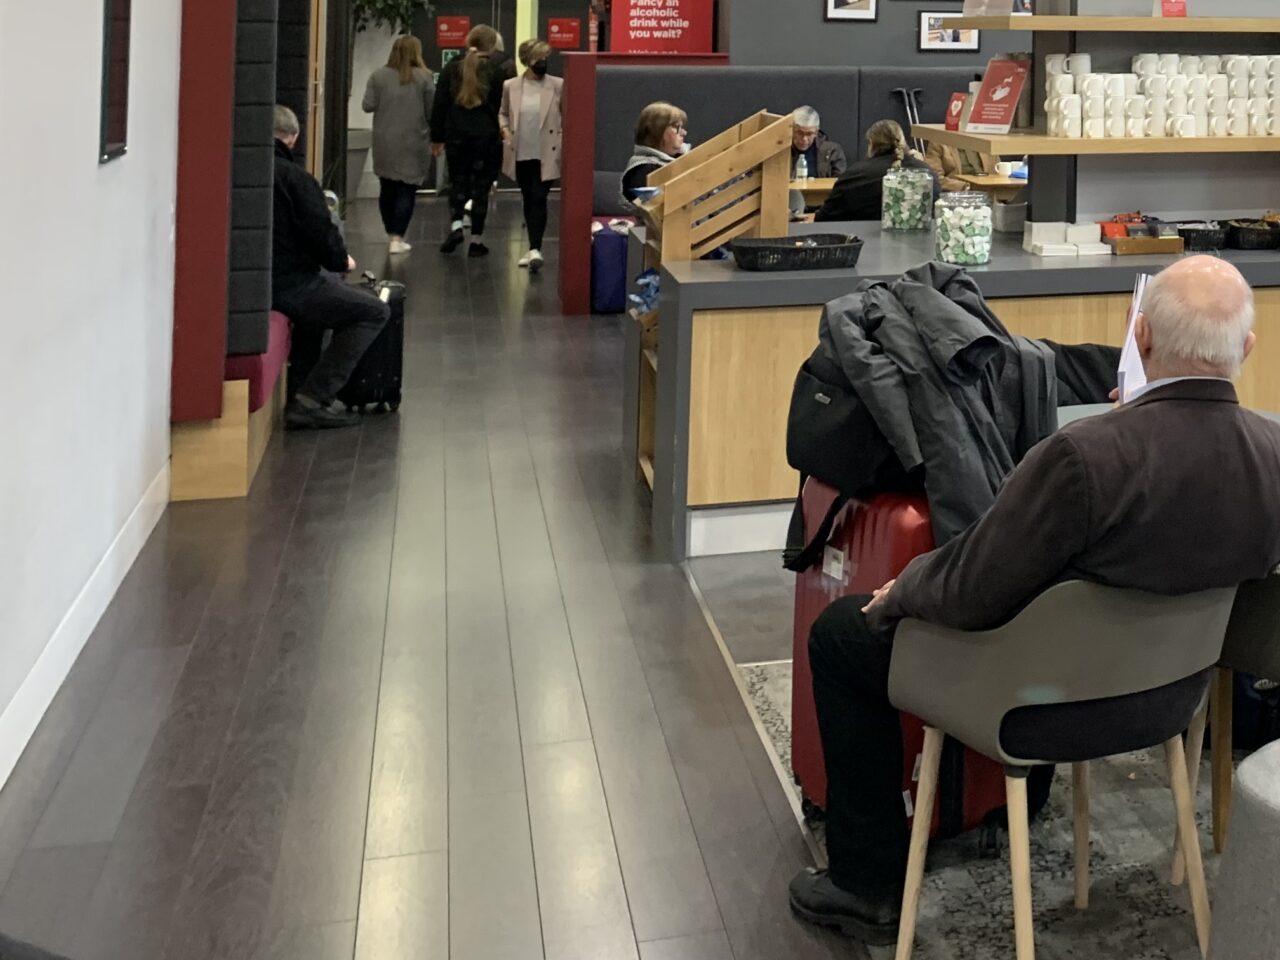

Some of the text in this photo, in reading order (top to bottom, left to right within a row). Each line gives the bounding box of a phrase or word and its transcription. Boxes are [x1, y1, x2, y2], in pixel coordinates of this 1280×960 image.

[629, 7, 679, 17] alcoholic
[629, 18, 689, 28] drink while
[629, 29, 682, 39] you wait?
